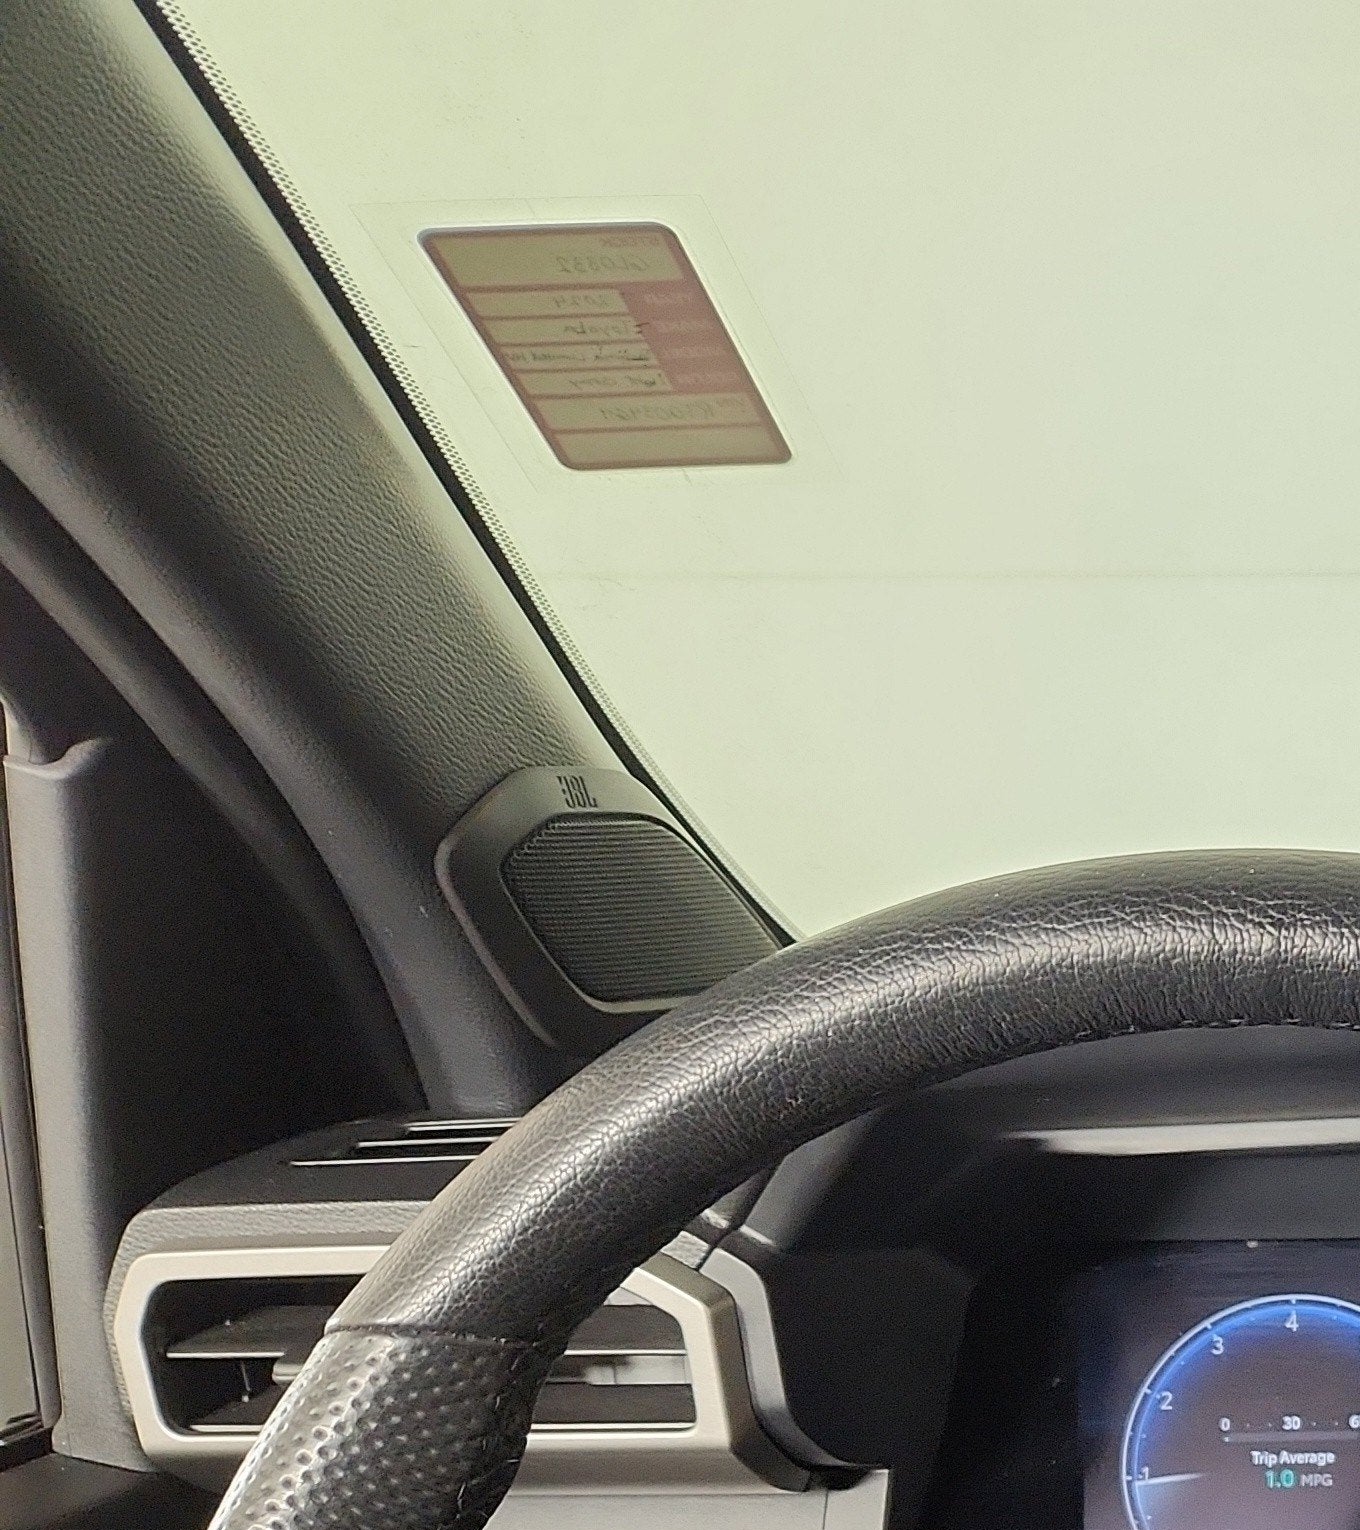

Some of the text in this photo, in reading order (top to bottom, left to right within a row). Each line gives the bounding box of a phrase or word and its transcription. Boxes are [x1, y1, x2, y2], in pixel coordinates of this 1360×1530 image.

[1284, 1312, 1300, 1333] 4
[1212, 1336, 1226, 1356] 3
[1160, 1393, 1174, 1411] 2
[1220, 1417, 1231, 1432] 0
[1281, 1416, 1302, 1431] 30
[1250, 1449, 1336, 1467] Trip Average
[1264, 1470, 1334, 1489] 1.0 MPG
